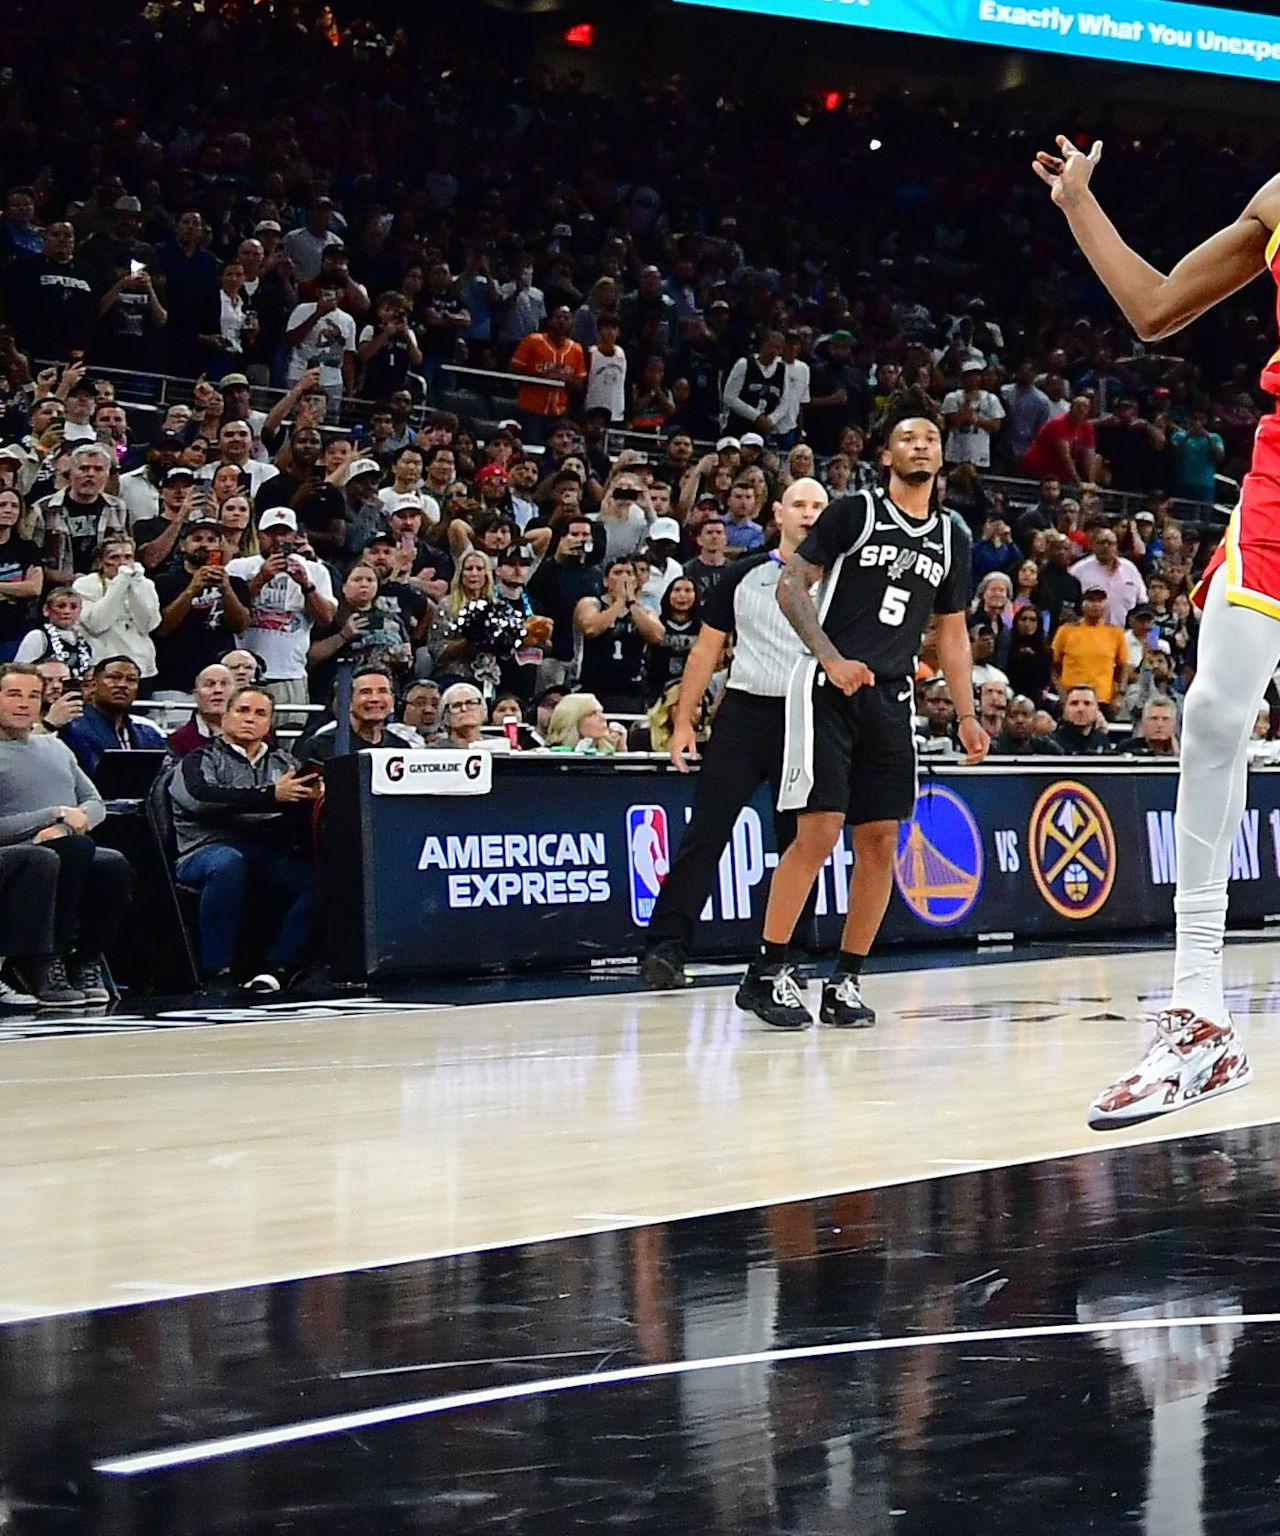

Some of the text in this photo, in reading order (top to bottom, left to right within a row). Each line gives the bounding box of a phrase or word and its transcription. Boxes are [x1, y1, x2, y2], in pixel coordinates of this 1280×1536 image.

[980, 0, 1073, 35] Exactly
[1079, 14, 1144, 41] What
[1149, 23, 1192, 47] You
[859, 544, 944, 589] SPURS
[878, 584, 912, 627] 5
[612, 640, 624, 661] 1
[409, 762, 460, 775] GATORADE
[417, 832, 606, 870] AMERICAN
[1146, 807, 1261, 885] MAY
[447, 869, 611, 909] EXPRESS
